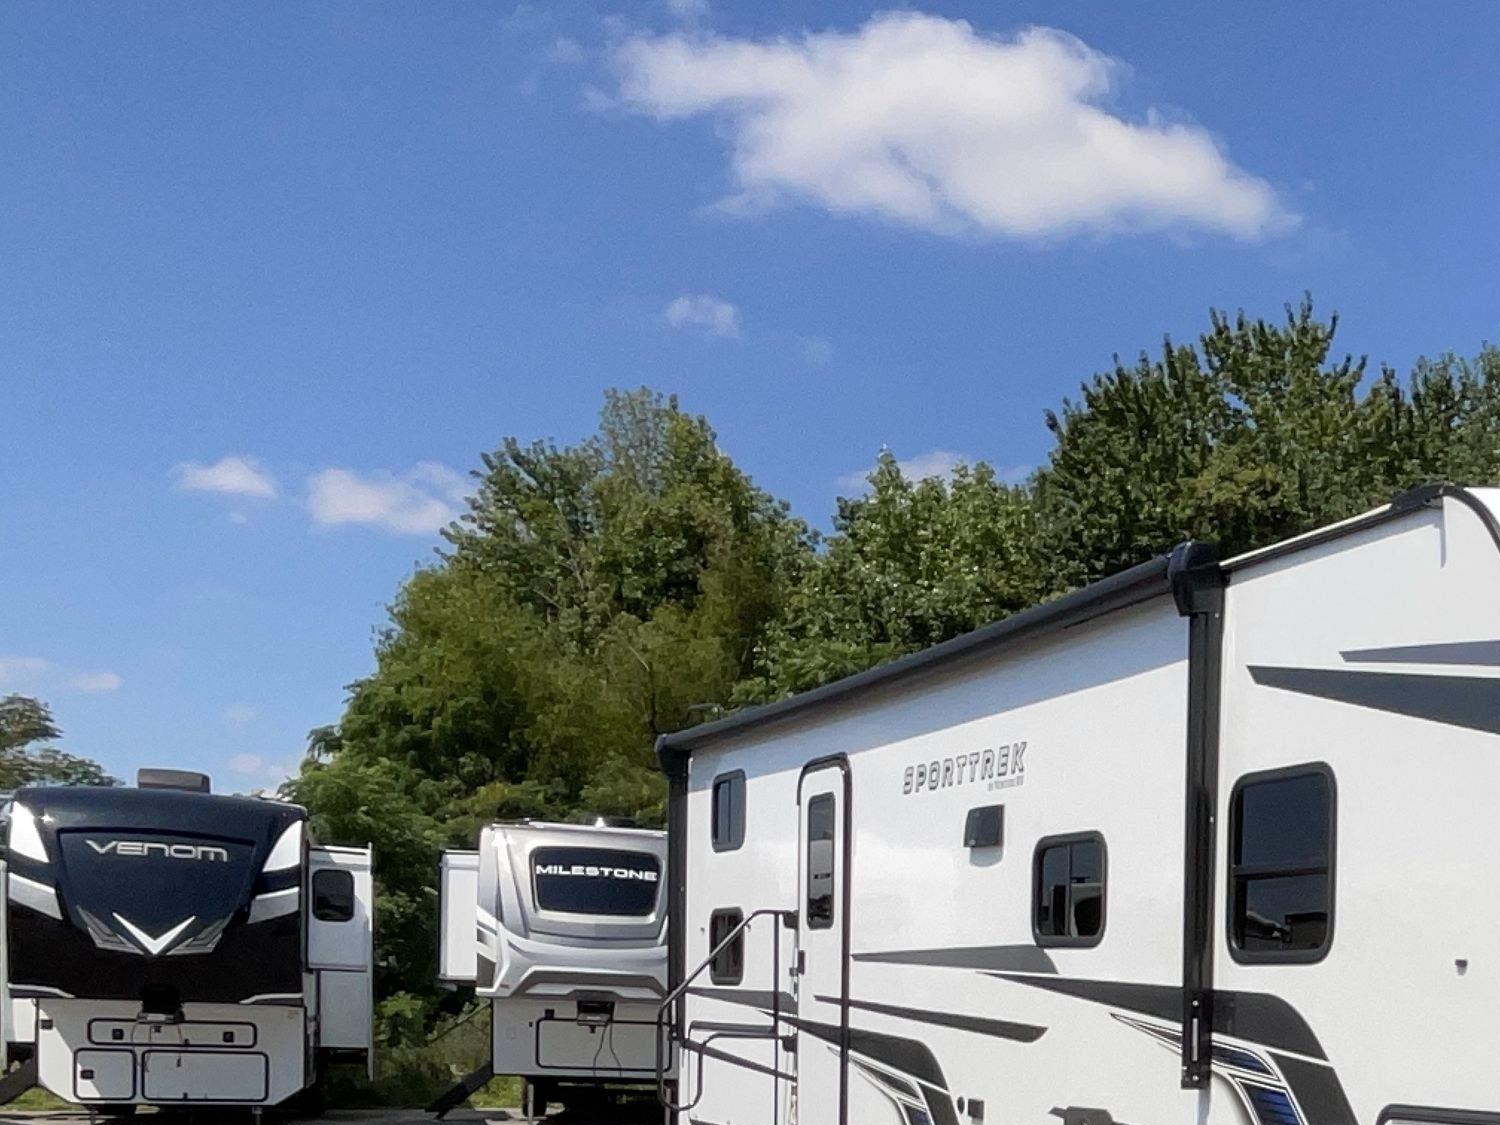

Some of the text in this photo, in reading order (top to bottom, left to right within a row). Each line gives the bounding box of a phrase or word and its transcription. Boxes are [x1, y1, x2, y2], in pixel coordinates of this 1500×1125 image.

[903, 741, 1027, 795] SPORTTREK
[86, 839, 228, 862] VENOM
[536, 864, 658, 881] MILESTONE
